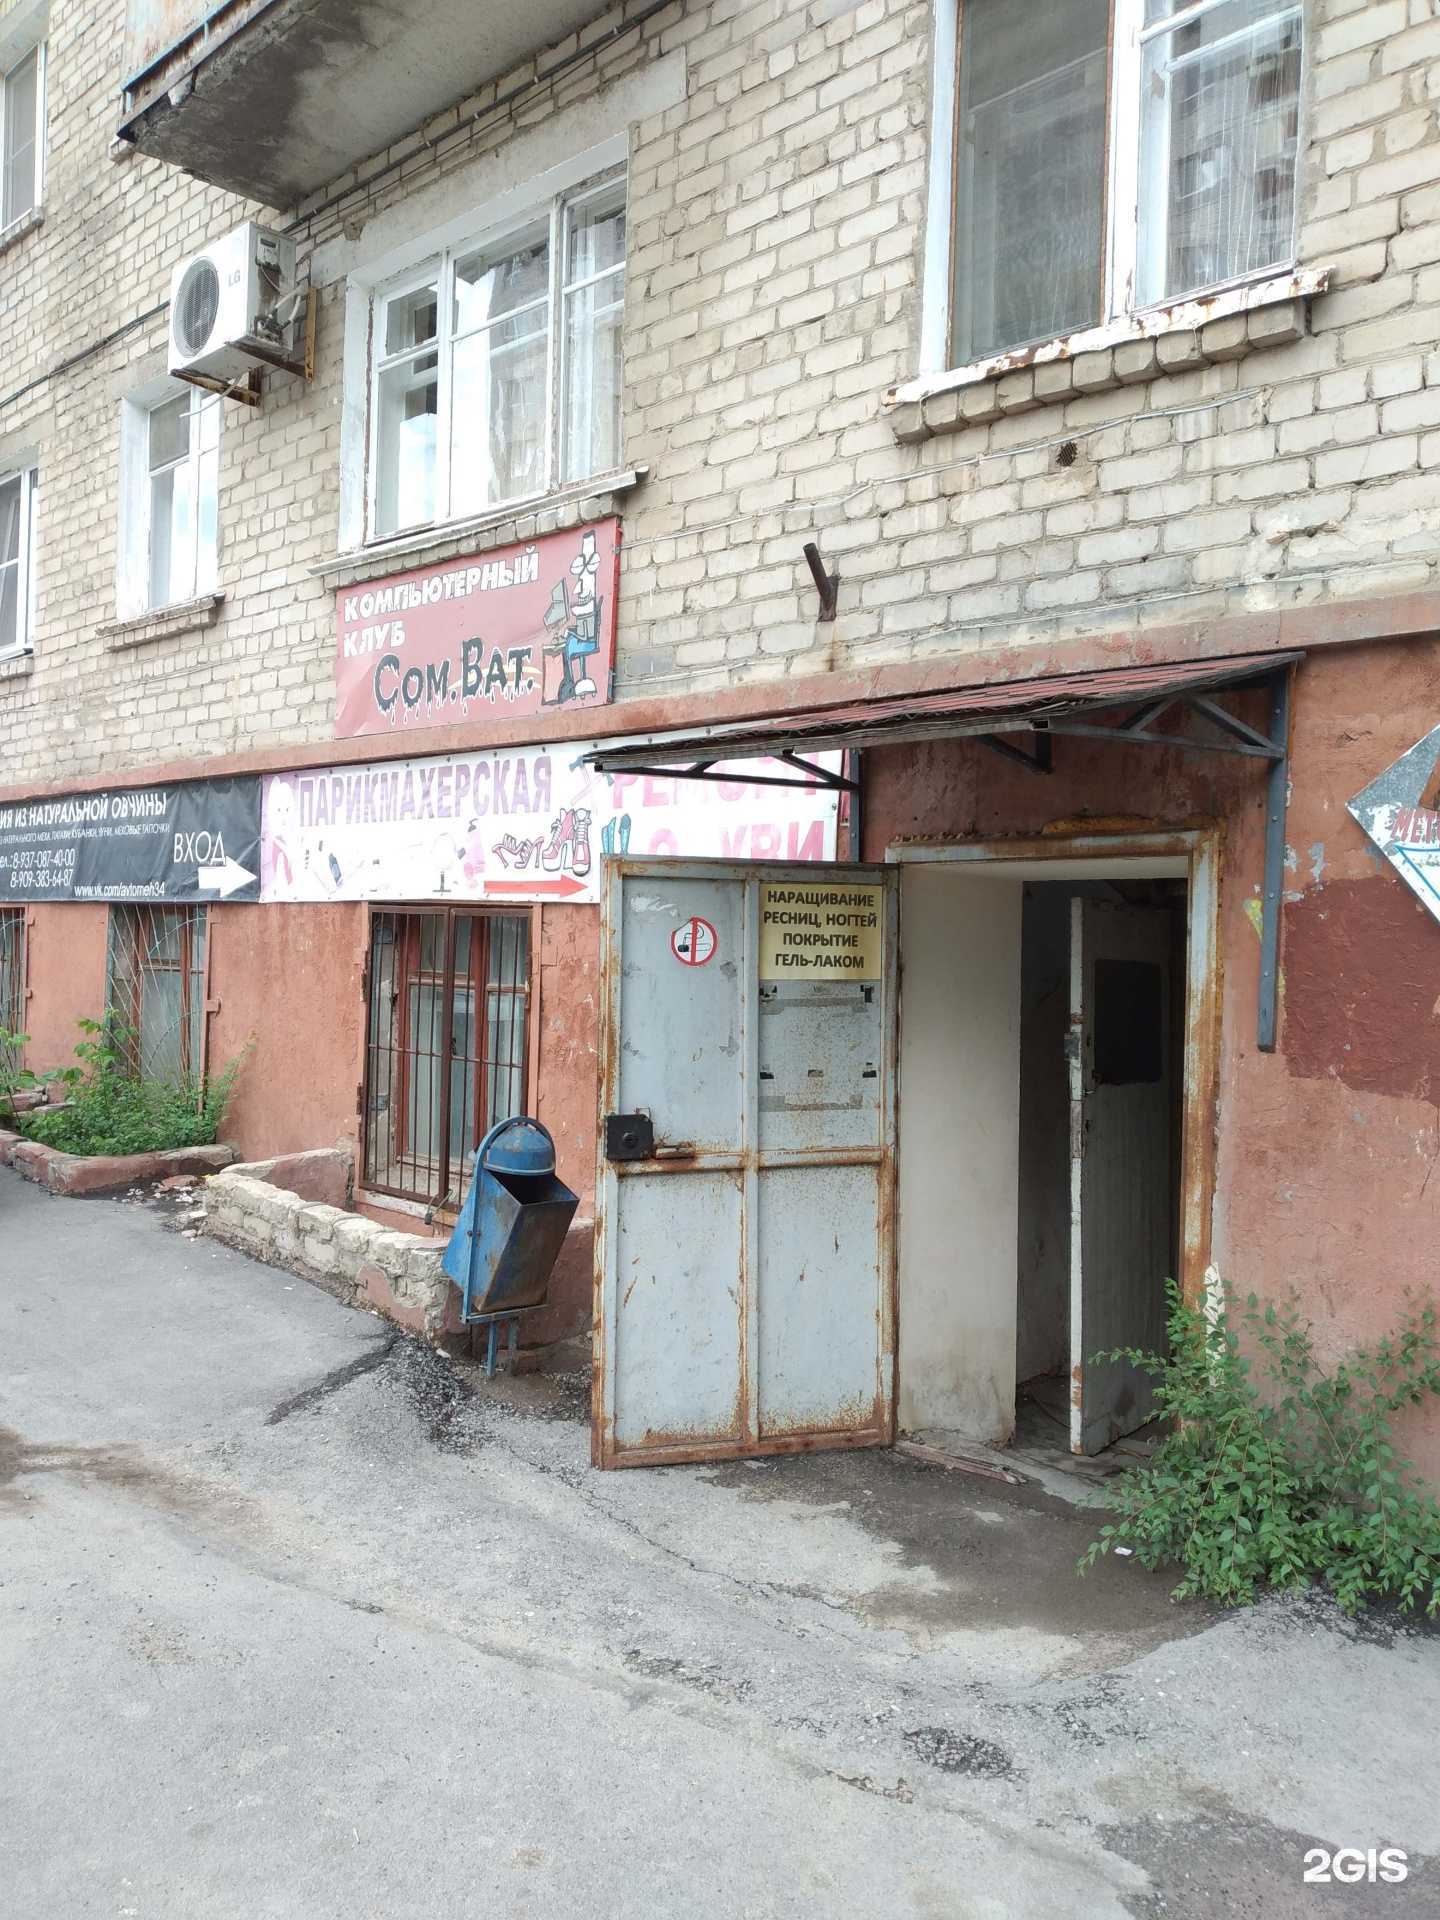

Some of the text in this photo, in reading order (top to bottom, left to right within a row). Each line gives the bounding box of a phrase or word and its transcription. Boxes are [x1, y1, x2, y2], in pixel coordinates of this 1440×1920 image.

[228, 269, 241, 287] LG
[344, 546, 540, 622] КОМПЬЮТЕРНЫЙ
[343, 621, 406, 657] КЛУБ
[300, 755, 552, 827] ПАРИКМАХЕРСКАЯ
[15, 807, 27, 828] ИЗ
[29, 794, 109, 827] НАТУРАЛЬНОЙ
[111, 792, 168, 818] ОВЧИНЫ
[173, 831, 226, 865] ВХОД
[10, 868, 74, 888] 8-909-383-64-87
[74, 881, 165, 897] www.vk.com/avtomeh34
[767, 890, 875, 908] НАРАЩИВАНИЕ
[763, 910, 877, 929] РЕСНИЦ, НОГТЕЙ
[783, 933, 859, 948] ПОКРЫТИЕ
[775, 953, 864, 969] ГЕЛЬ-ЛАКОМ
